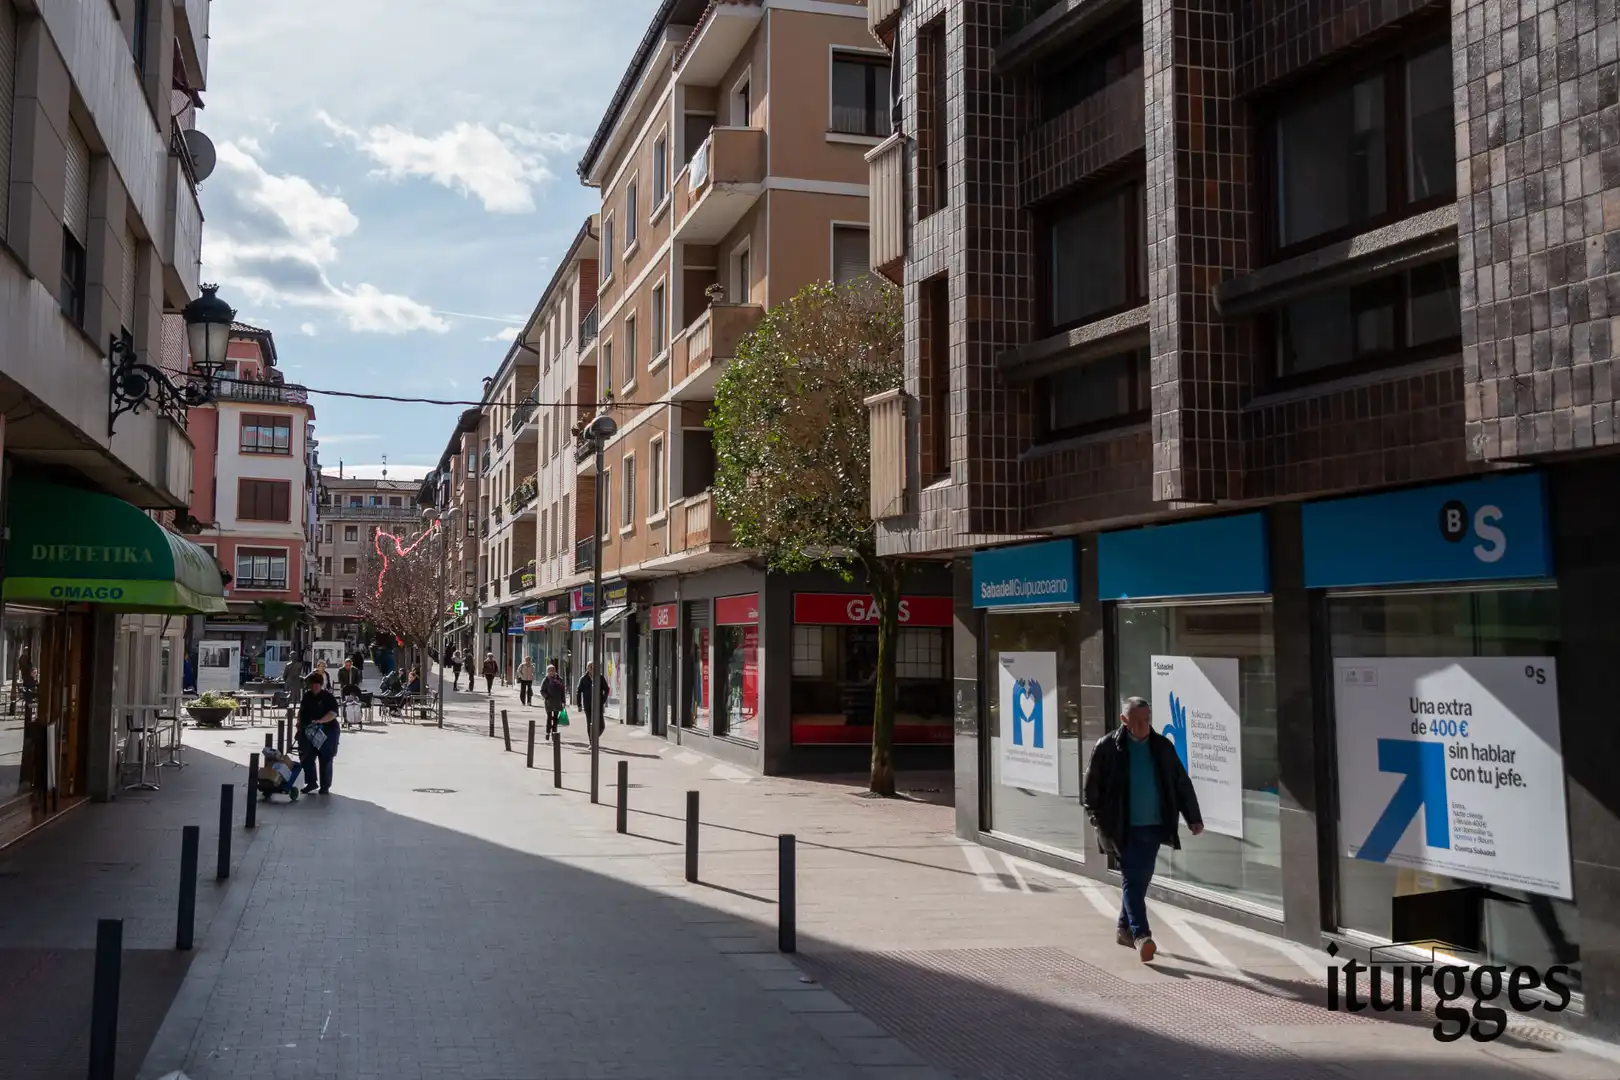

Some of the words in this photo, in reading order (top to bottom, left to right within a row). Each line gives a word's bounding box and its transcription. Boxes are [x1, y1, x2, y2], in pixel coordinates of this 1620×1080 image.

[32, 544, 154, 564] DIETETIKA
[50, 585, 124, 600] OMAGO
[846, 599, 911, 622] GAS
[1409, 697, 1434, 715] Una
[1437, 699, 1472, 717] extra
[1411, 718, 1427, 736] de
[1448, 742, 1469, 760] sin
[1472, 744, 1516, 764] hablar
[1450, 768, 1475, 783] con
[1477, 767, 1493, 784] tu
[1494, 768, 1527, 789] jefe.
